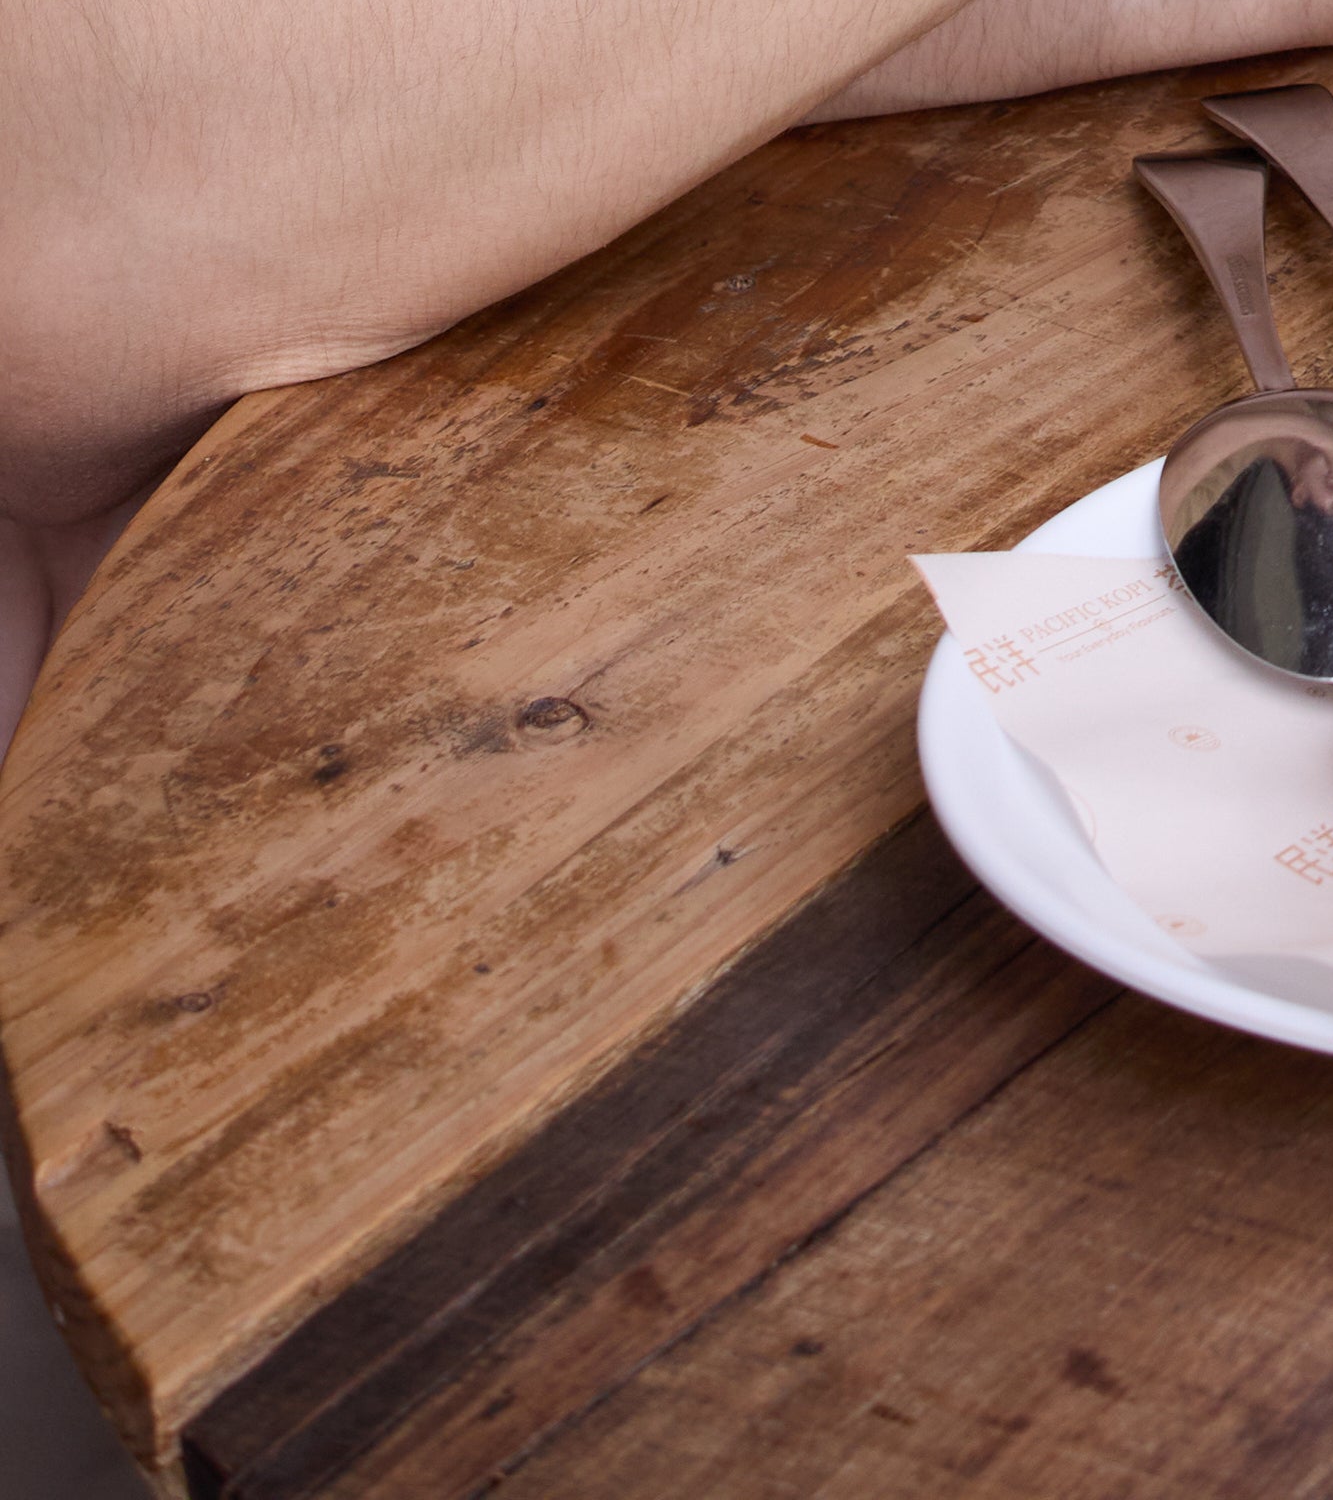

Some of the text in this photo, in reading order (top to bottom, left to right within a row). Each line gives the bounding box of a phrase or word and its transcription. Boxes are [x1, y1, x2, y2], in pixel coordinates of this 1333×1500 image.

[1019, 601, 1102, 643] PACIFIC
[1098, 579, 1154, 610] KOPI
[963, 634, 1040, 694] 民洋
